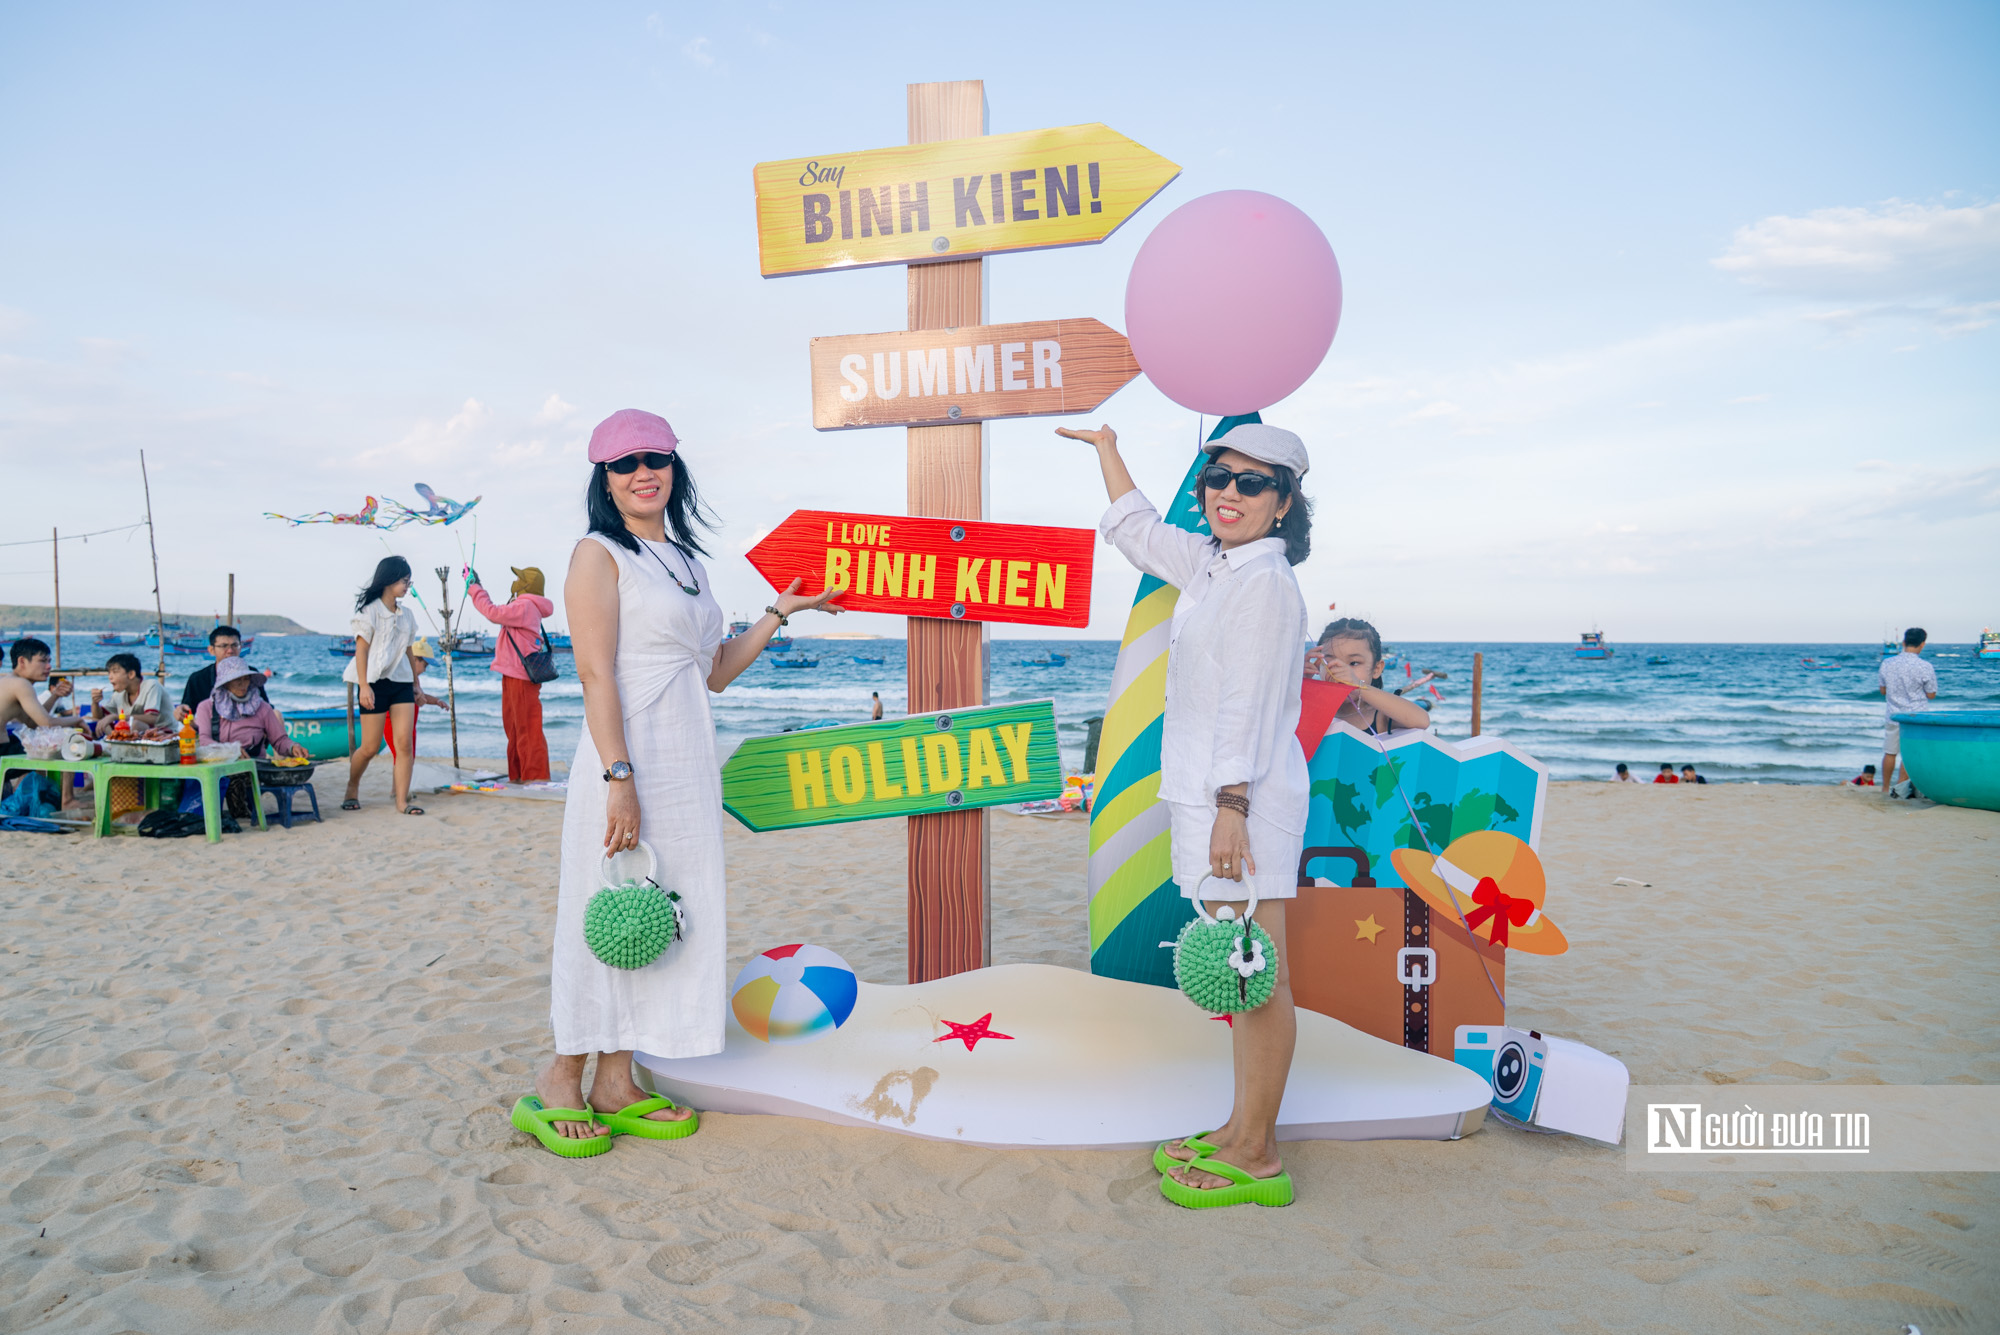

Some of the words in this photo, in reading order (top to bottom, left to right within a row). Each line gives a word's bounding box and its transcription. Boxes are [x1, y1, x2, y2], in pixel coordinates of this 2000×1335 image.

[799, 161, 845, 189] Say
[803, 181, 930, 244] BINH
[953, 162, 1102, 228] KIEN!
[839, 340, 1063, 403] SUMMER
[826, 522, 833, 543] I
[841, 523, 891, 547] LOVE
[824, 548, 937, 600] BINH
[955, 557, 1067, 609] KIEN
[787, 722, 1033, 810] HOLIDAY
